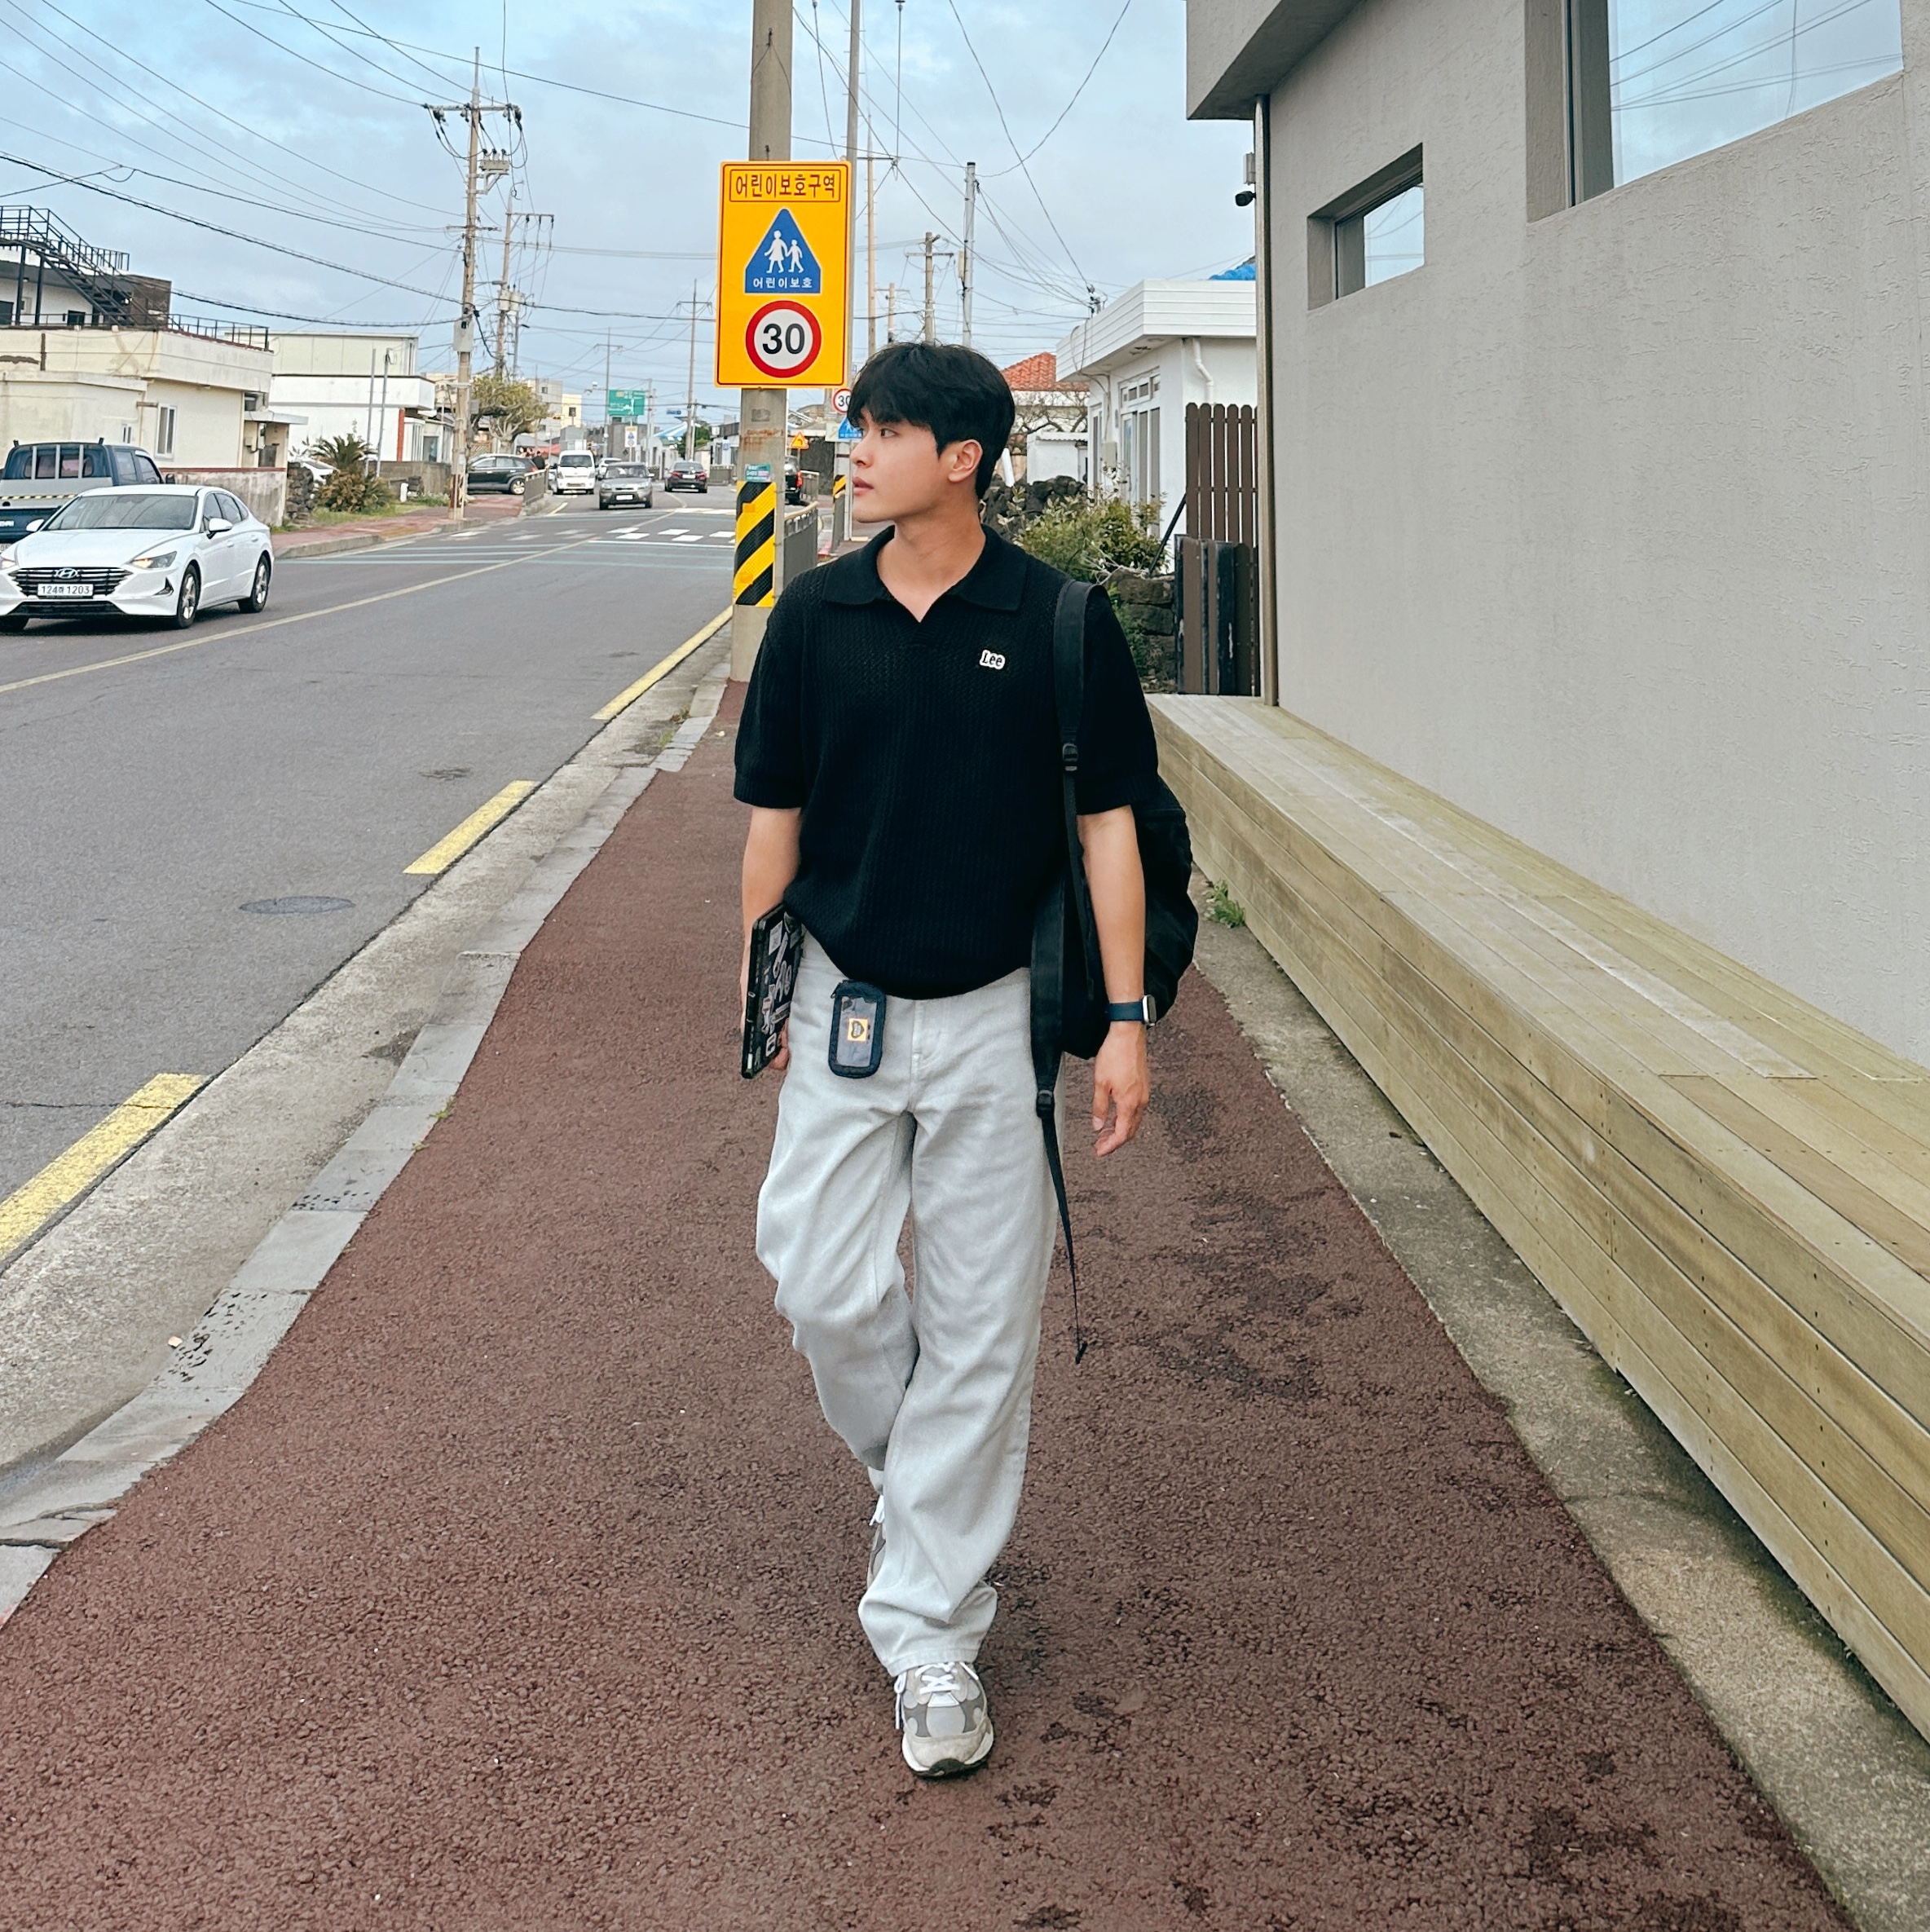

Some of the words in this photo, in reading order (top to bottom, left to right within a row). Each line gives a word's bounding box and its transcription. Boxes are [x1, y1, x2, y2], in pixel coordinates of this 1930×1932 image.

[735, 173, 835, 198] 어린이보호구역
[752, 276, 813, 289] 어린이보호
[762, 323, 805, 355] 30
[67, 585, 90, 595] 1203
[981, 651, 1003, 668] Lee
